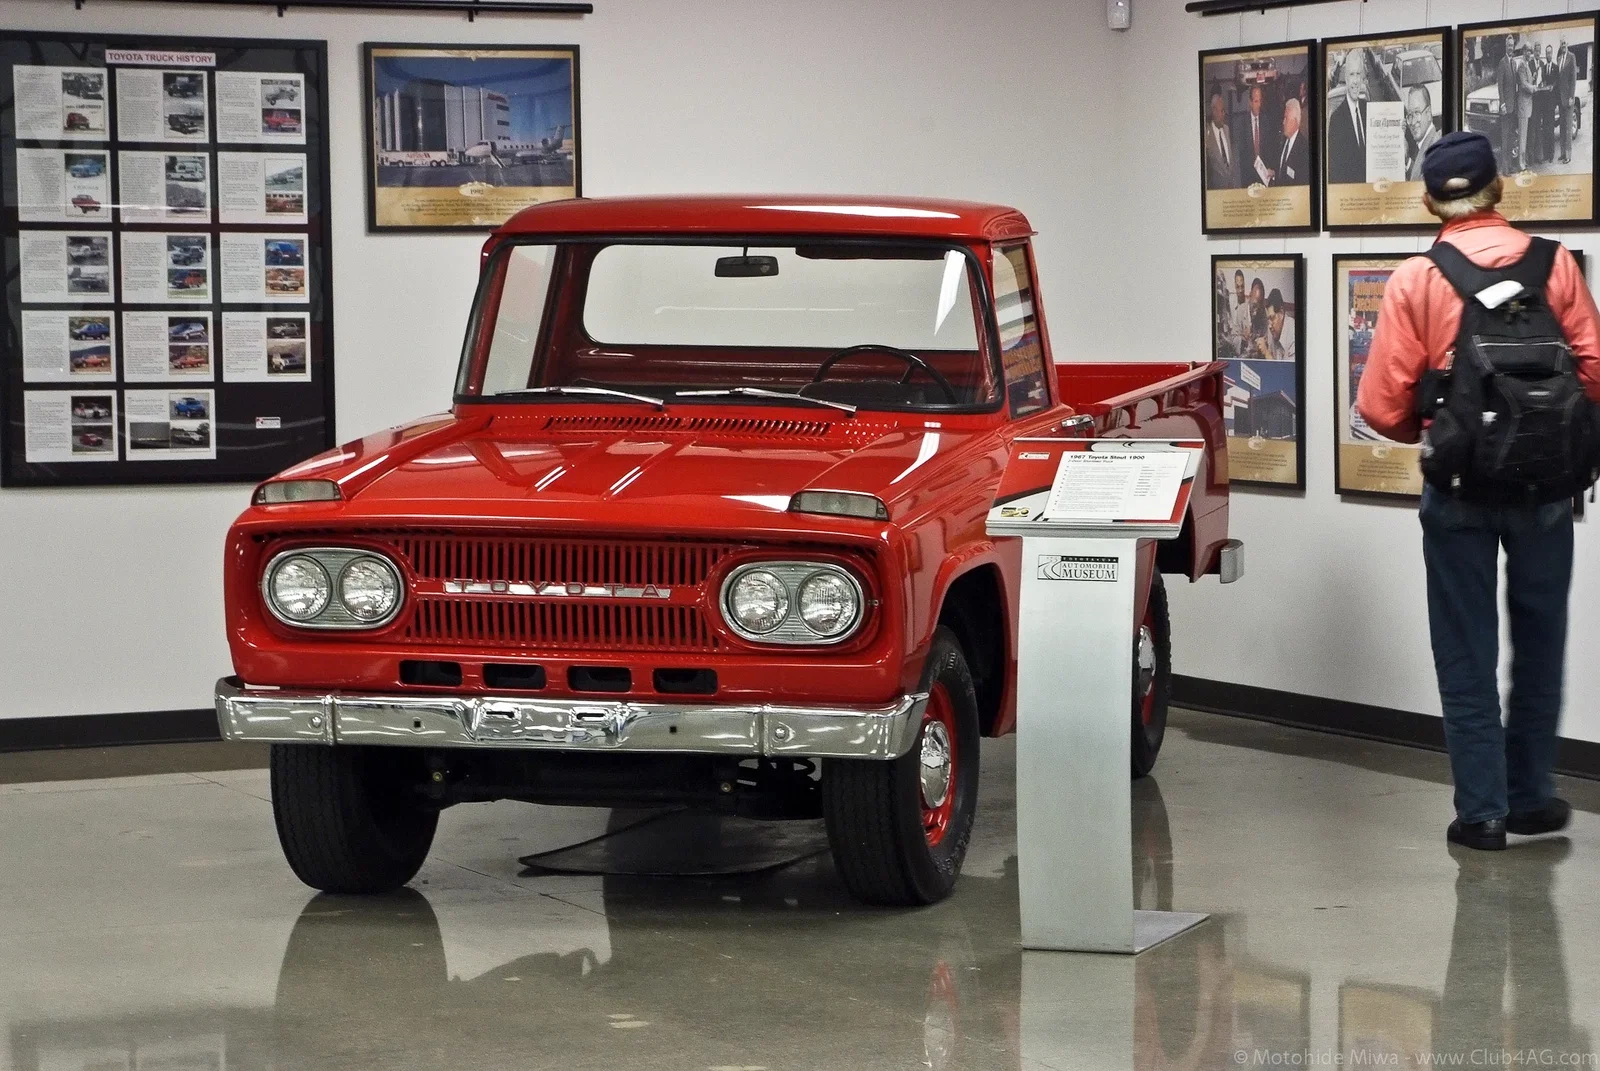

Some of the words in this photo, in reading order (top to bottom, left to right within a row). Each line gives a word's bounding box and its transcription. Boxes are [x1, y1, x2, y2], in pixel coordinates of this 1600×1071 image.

[108, 52, 144, 61] TOYOTA
[145, 54, 174, 62] TRUCK
[176, 55, 213, 63] HISTORY
[1062, 569, 1115, 579] MUSEUM
[453, 578, 661, 598] TOYOTA
